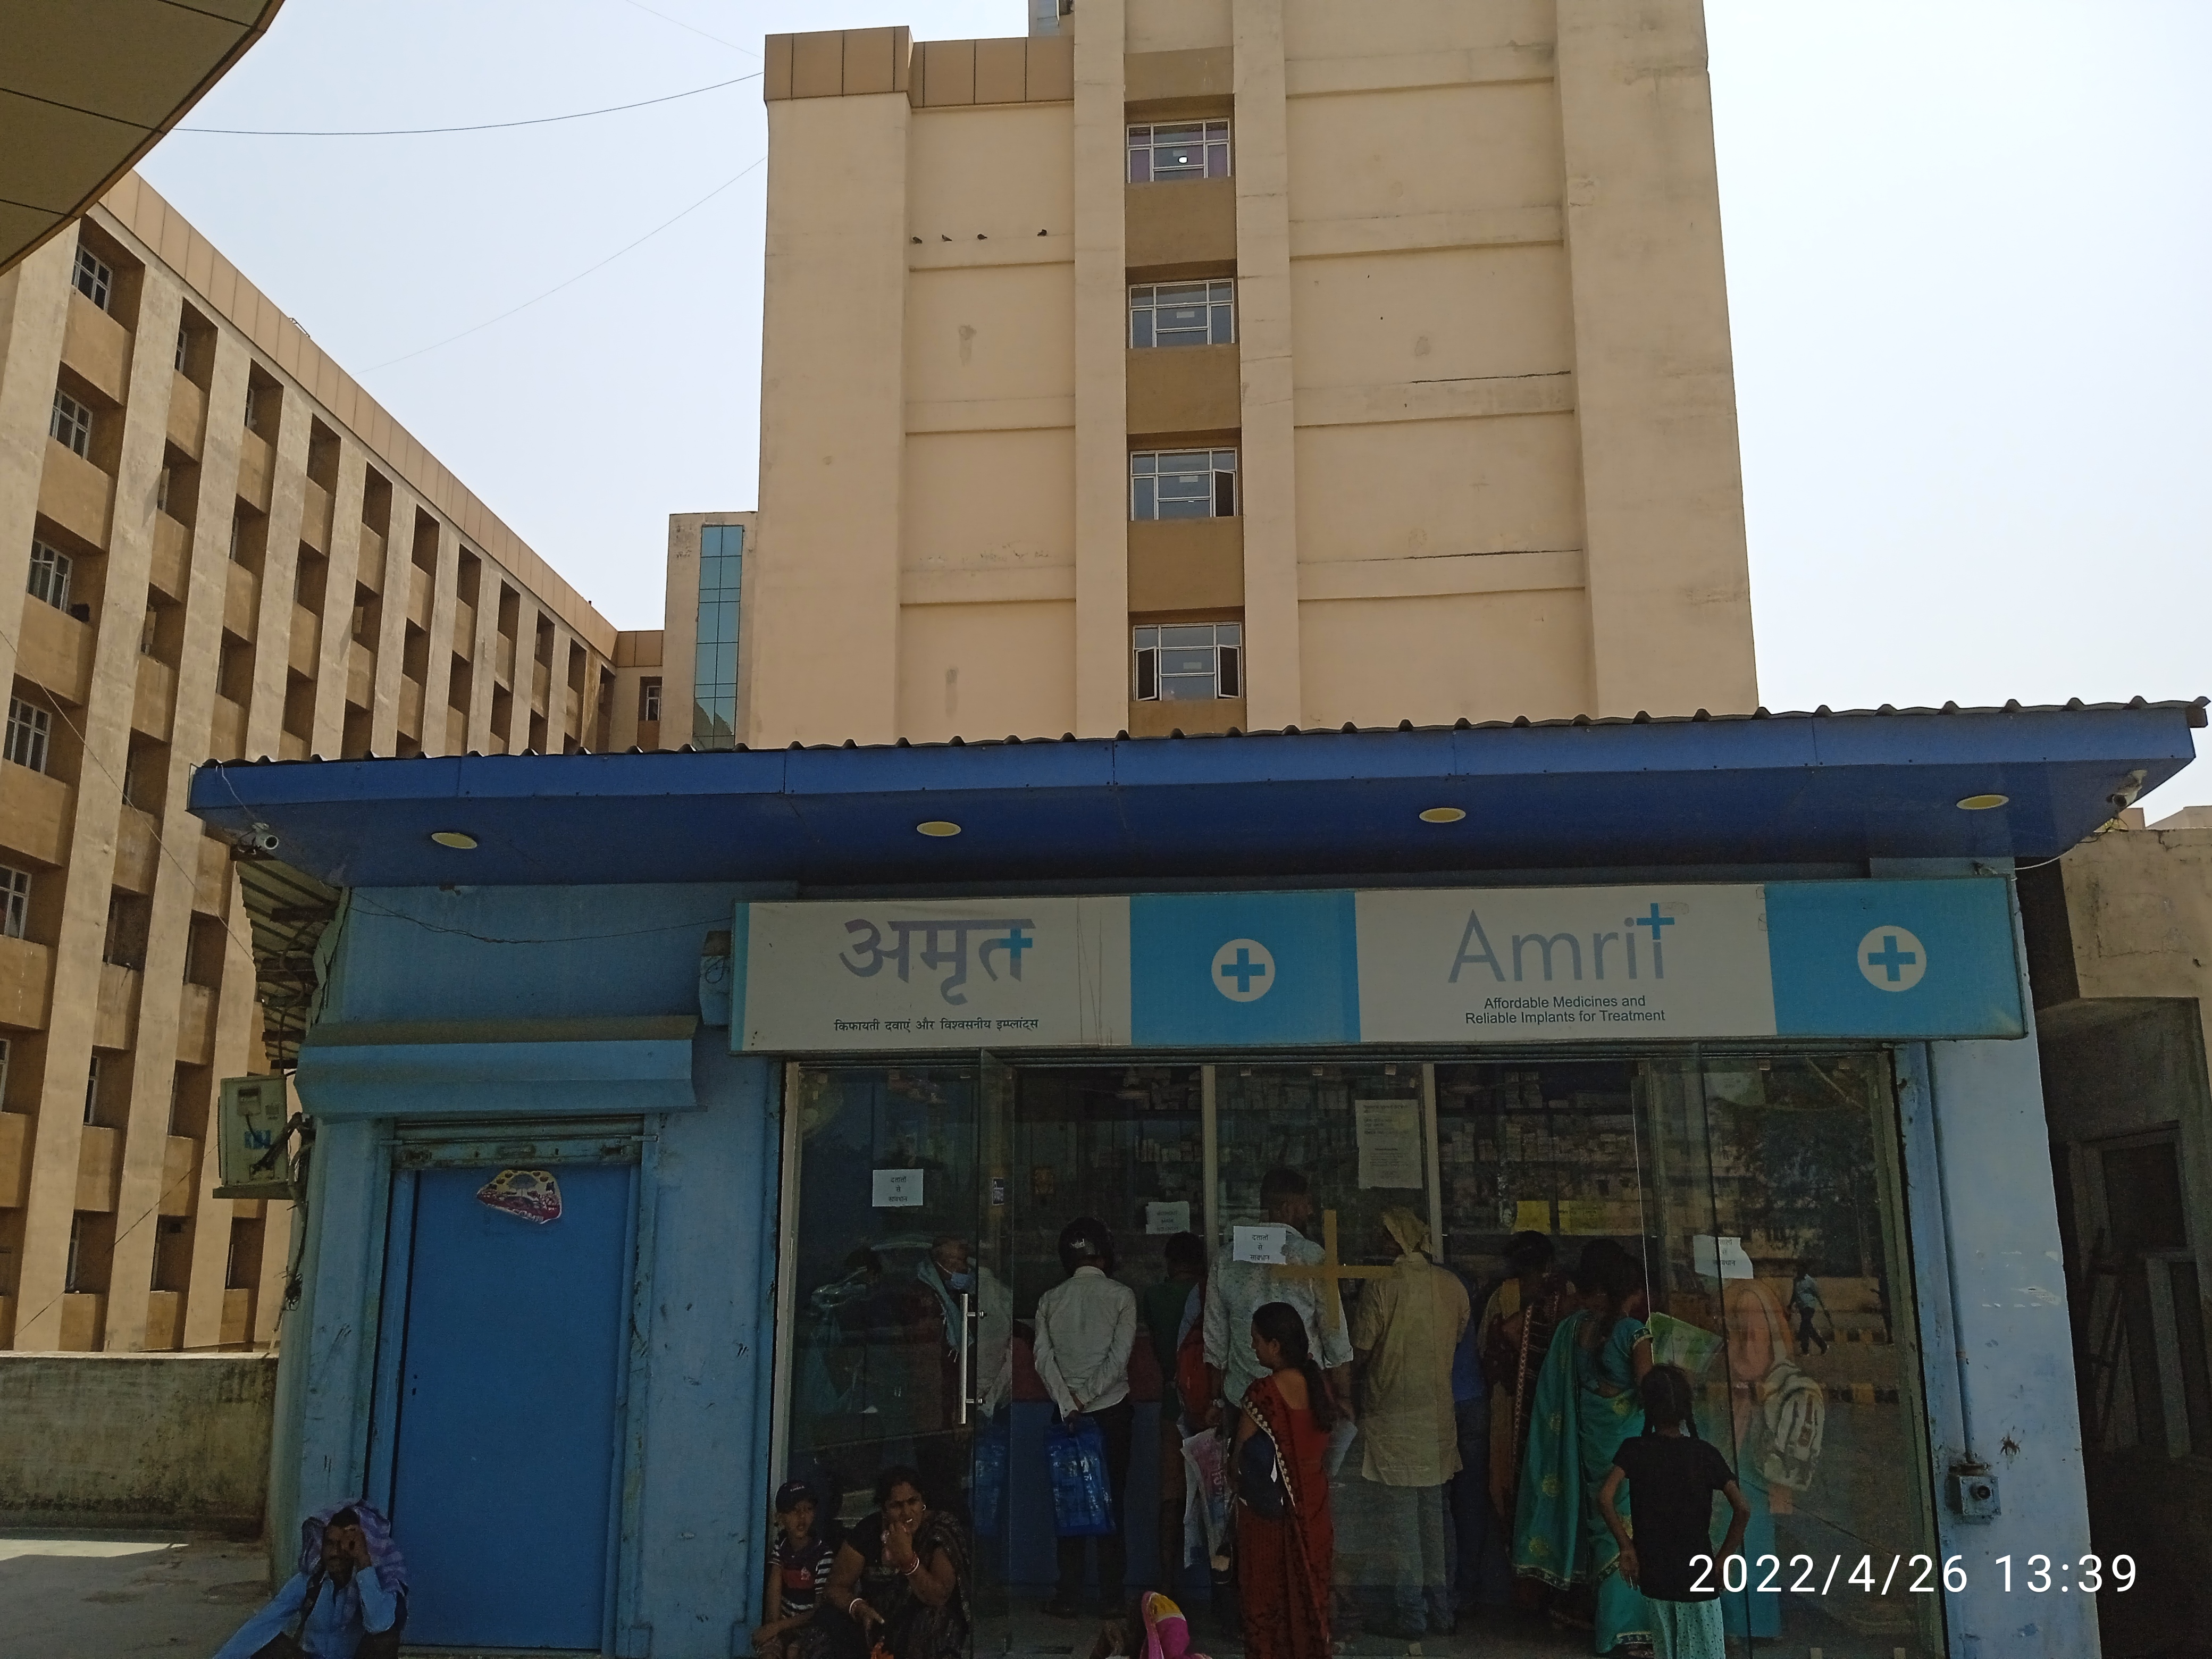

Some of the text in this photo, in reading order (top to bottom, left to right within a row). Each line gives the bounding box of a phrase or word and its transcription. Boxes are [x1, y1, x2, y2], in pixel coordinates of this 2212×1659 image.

[1448, 902, 1675, 983] Amrit
[839, 918, 1036, 1006] अमृत
[1484, 995, 1646, 1009] Affordable Medicines and
[834, 1019, 880, 1032] किफायती
[885, 1018, 911, 1033] दवाएं
[916, 1017, 935, 1030] और
[940, 1017, 992, 1030] विश्वसनीय
[1465, 1009, 1665, 1025] Reliable Implants for Treatment
